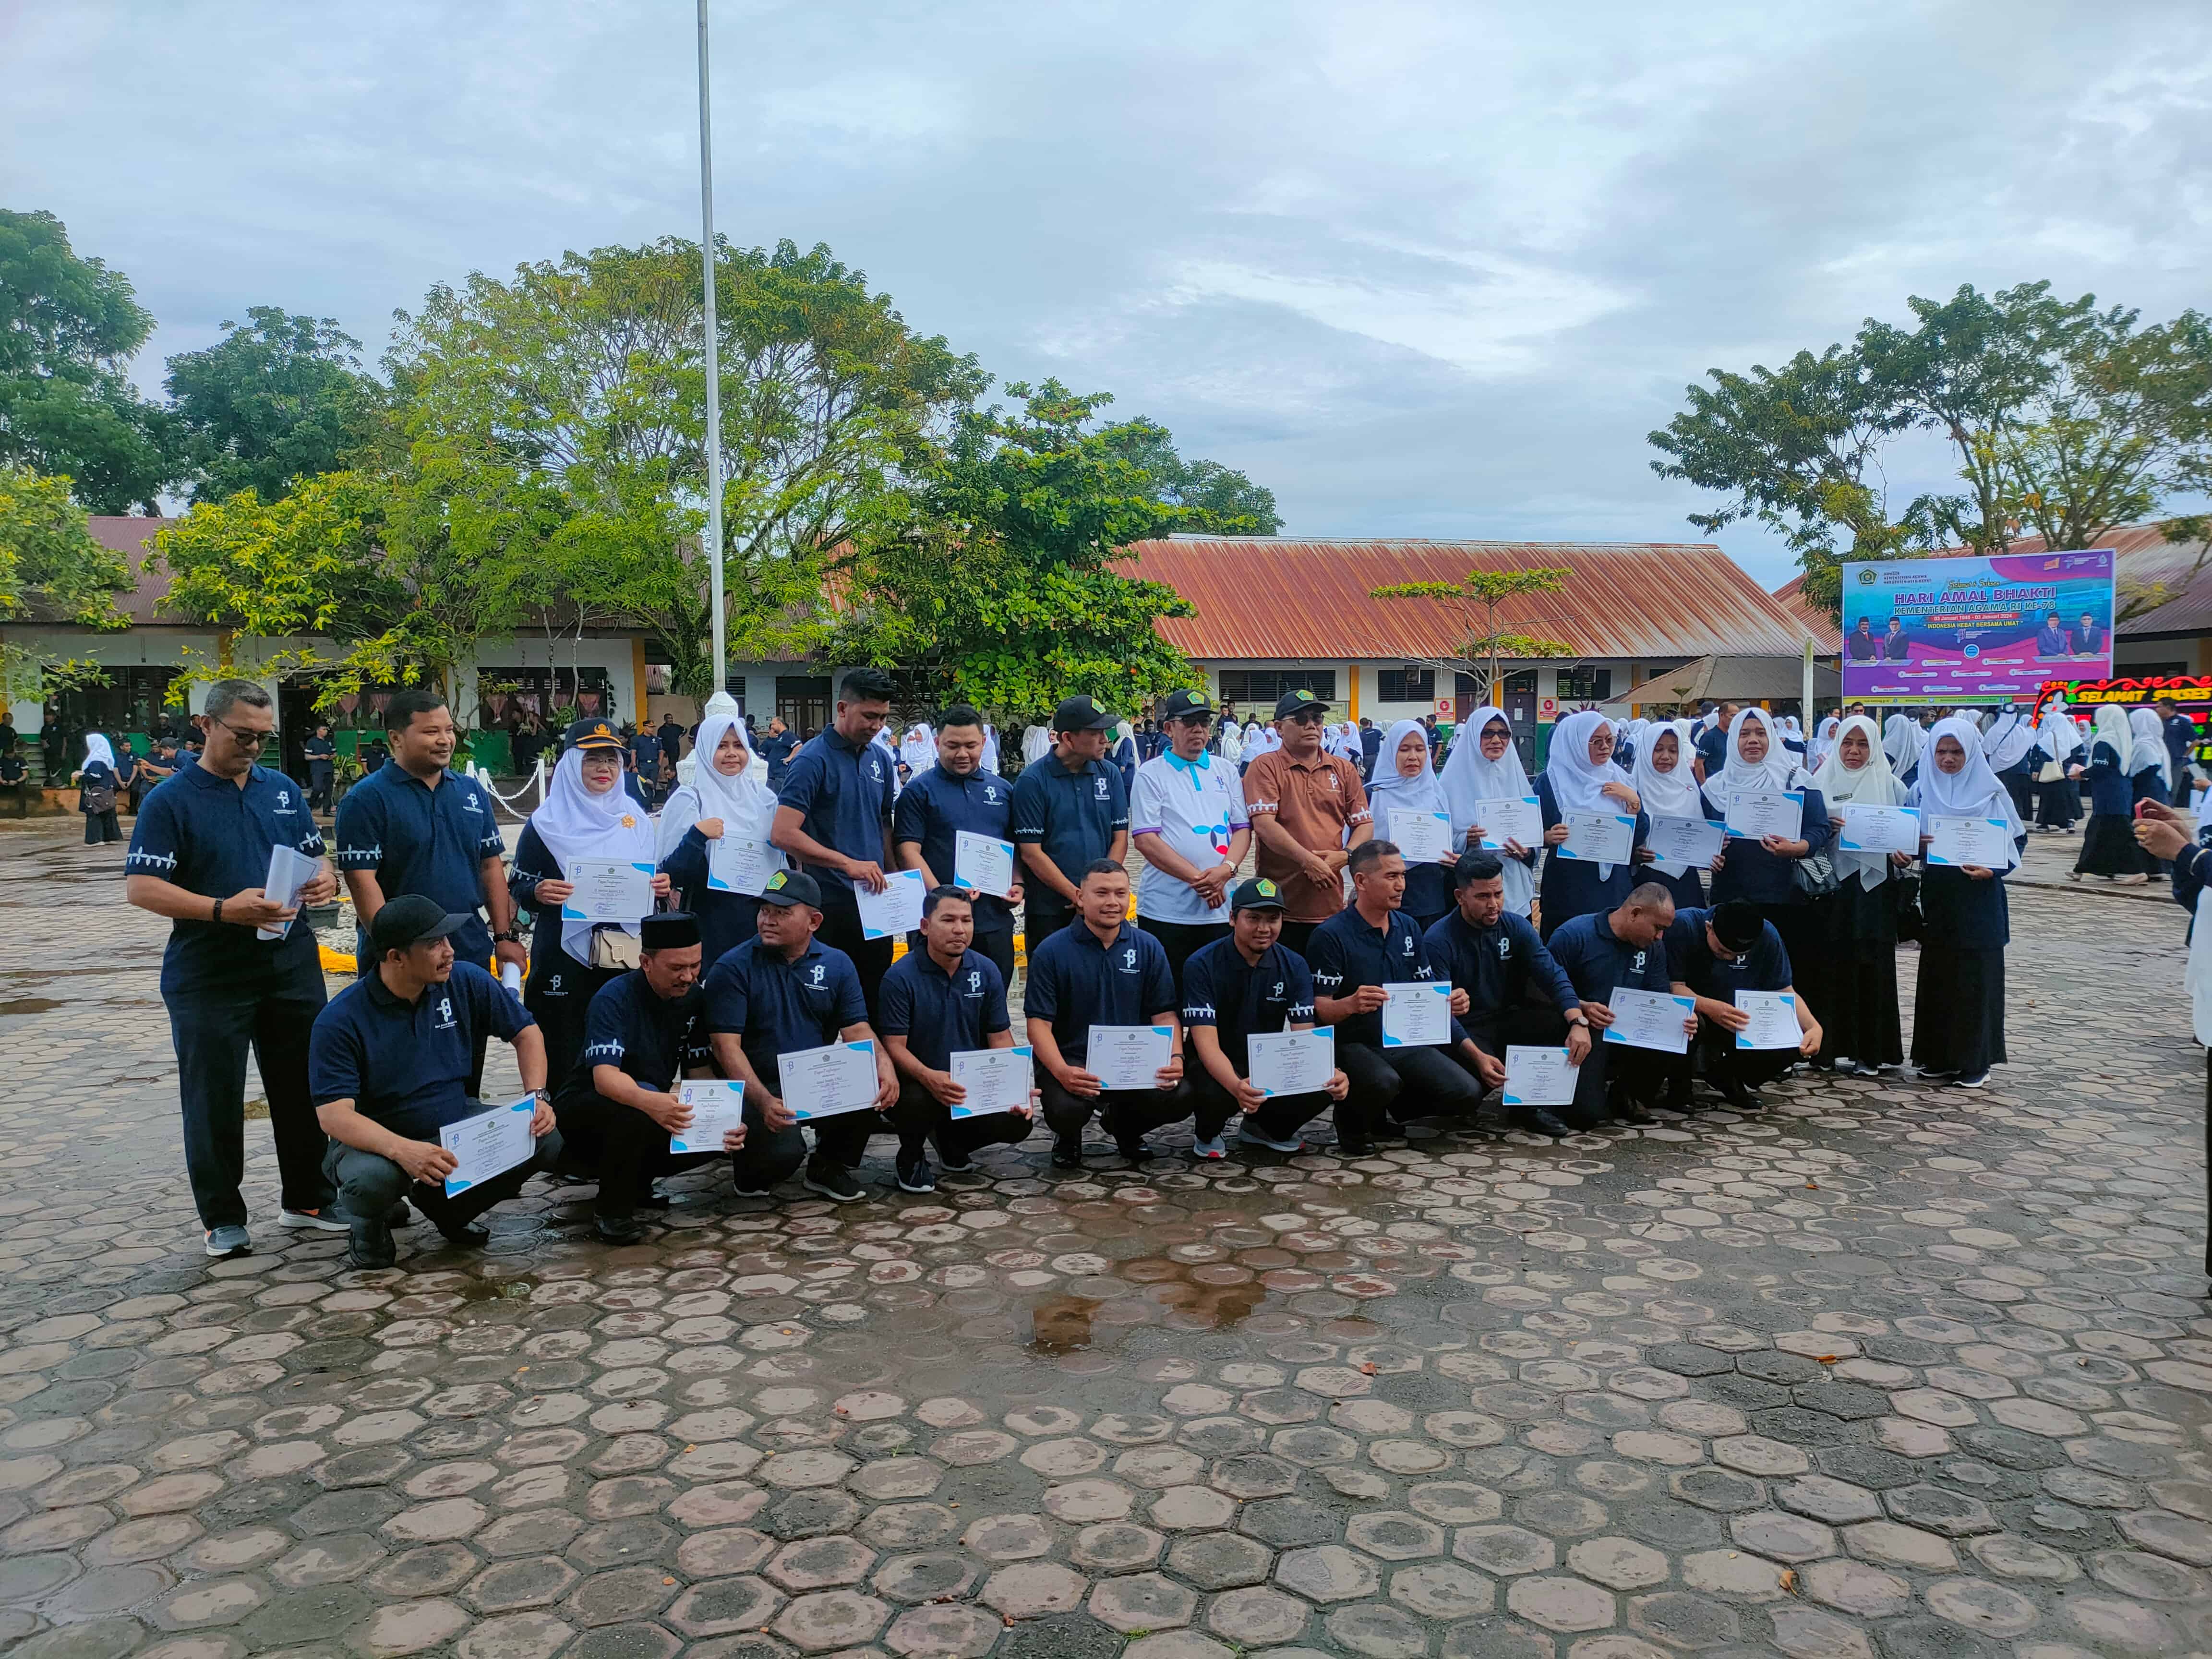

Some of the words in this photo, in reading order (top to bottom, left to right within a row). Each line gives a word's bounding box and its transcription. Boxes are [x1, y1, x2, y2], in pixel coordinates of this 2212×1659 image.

[1948, 580, 1972, 589] Selamat
[1977, 577, 2000, 588] Sukses
[1894, 592, 1935, 605] HARI
[1939, 590, 1987, 603] AMAL
[1993, 586, 2057, 601] BHAKTI
[1894, 604, 1965, 615] KEMENTERIAN
[1968, 602, 2008, 613] AGAMA
[2010, 602, 2022, 611] RI
[2024, 601, 2056, 611] KE-78
[2078, 690, 2147, 703] SELAMAT
